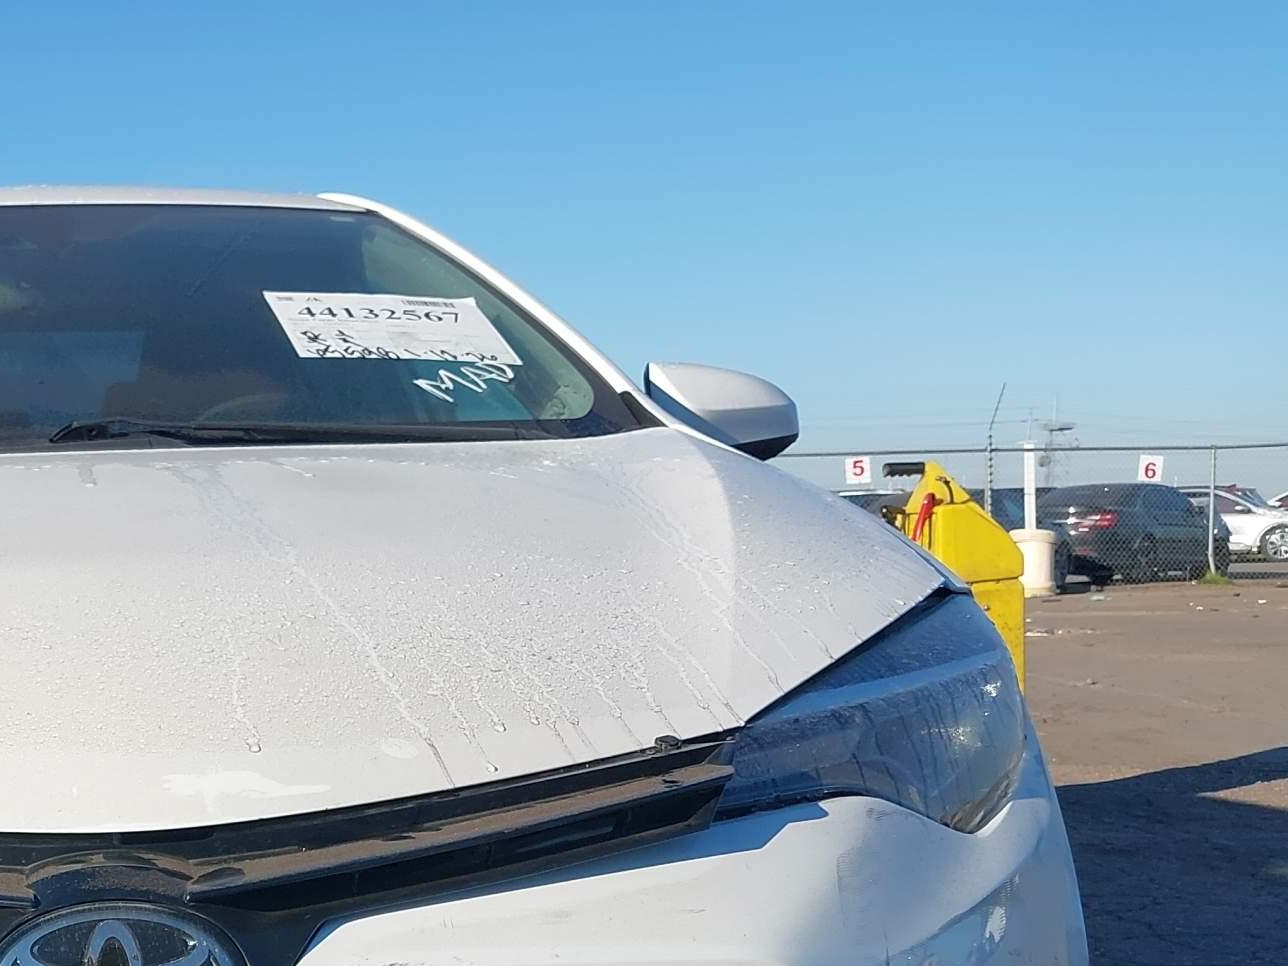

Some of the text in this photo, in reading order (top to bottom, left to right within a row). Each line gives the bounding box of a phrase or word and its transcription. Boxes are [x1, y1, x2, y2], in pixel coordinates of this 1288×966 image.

[297, 305, 459, 323] 44132567
[852, 459, 865, 477] 5
[1144, 461, 1157, 479] 6
